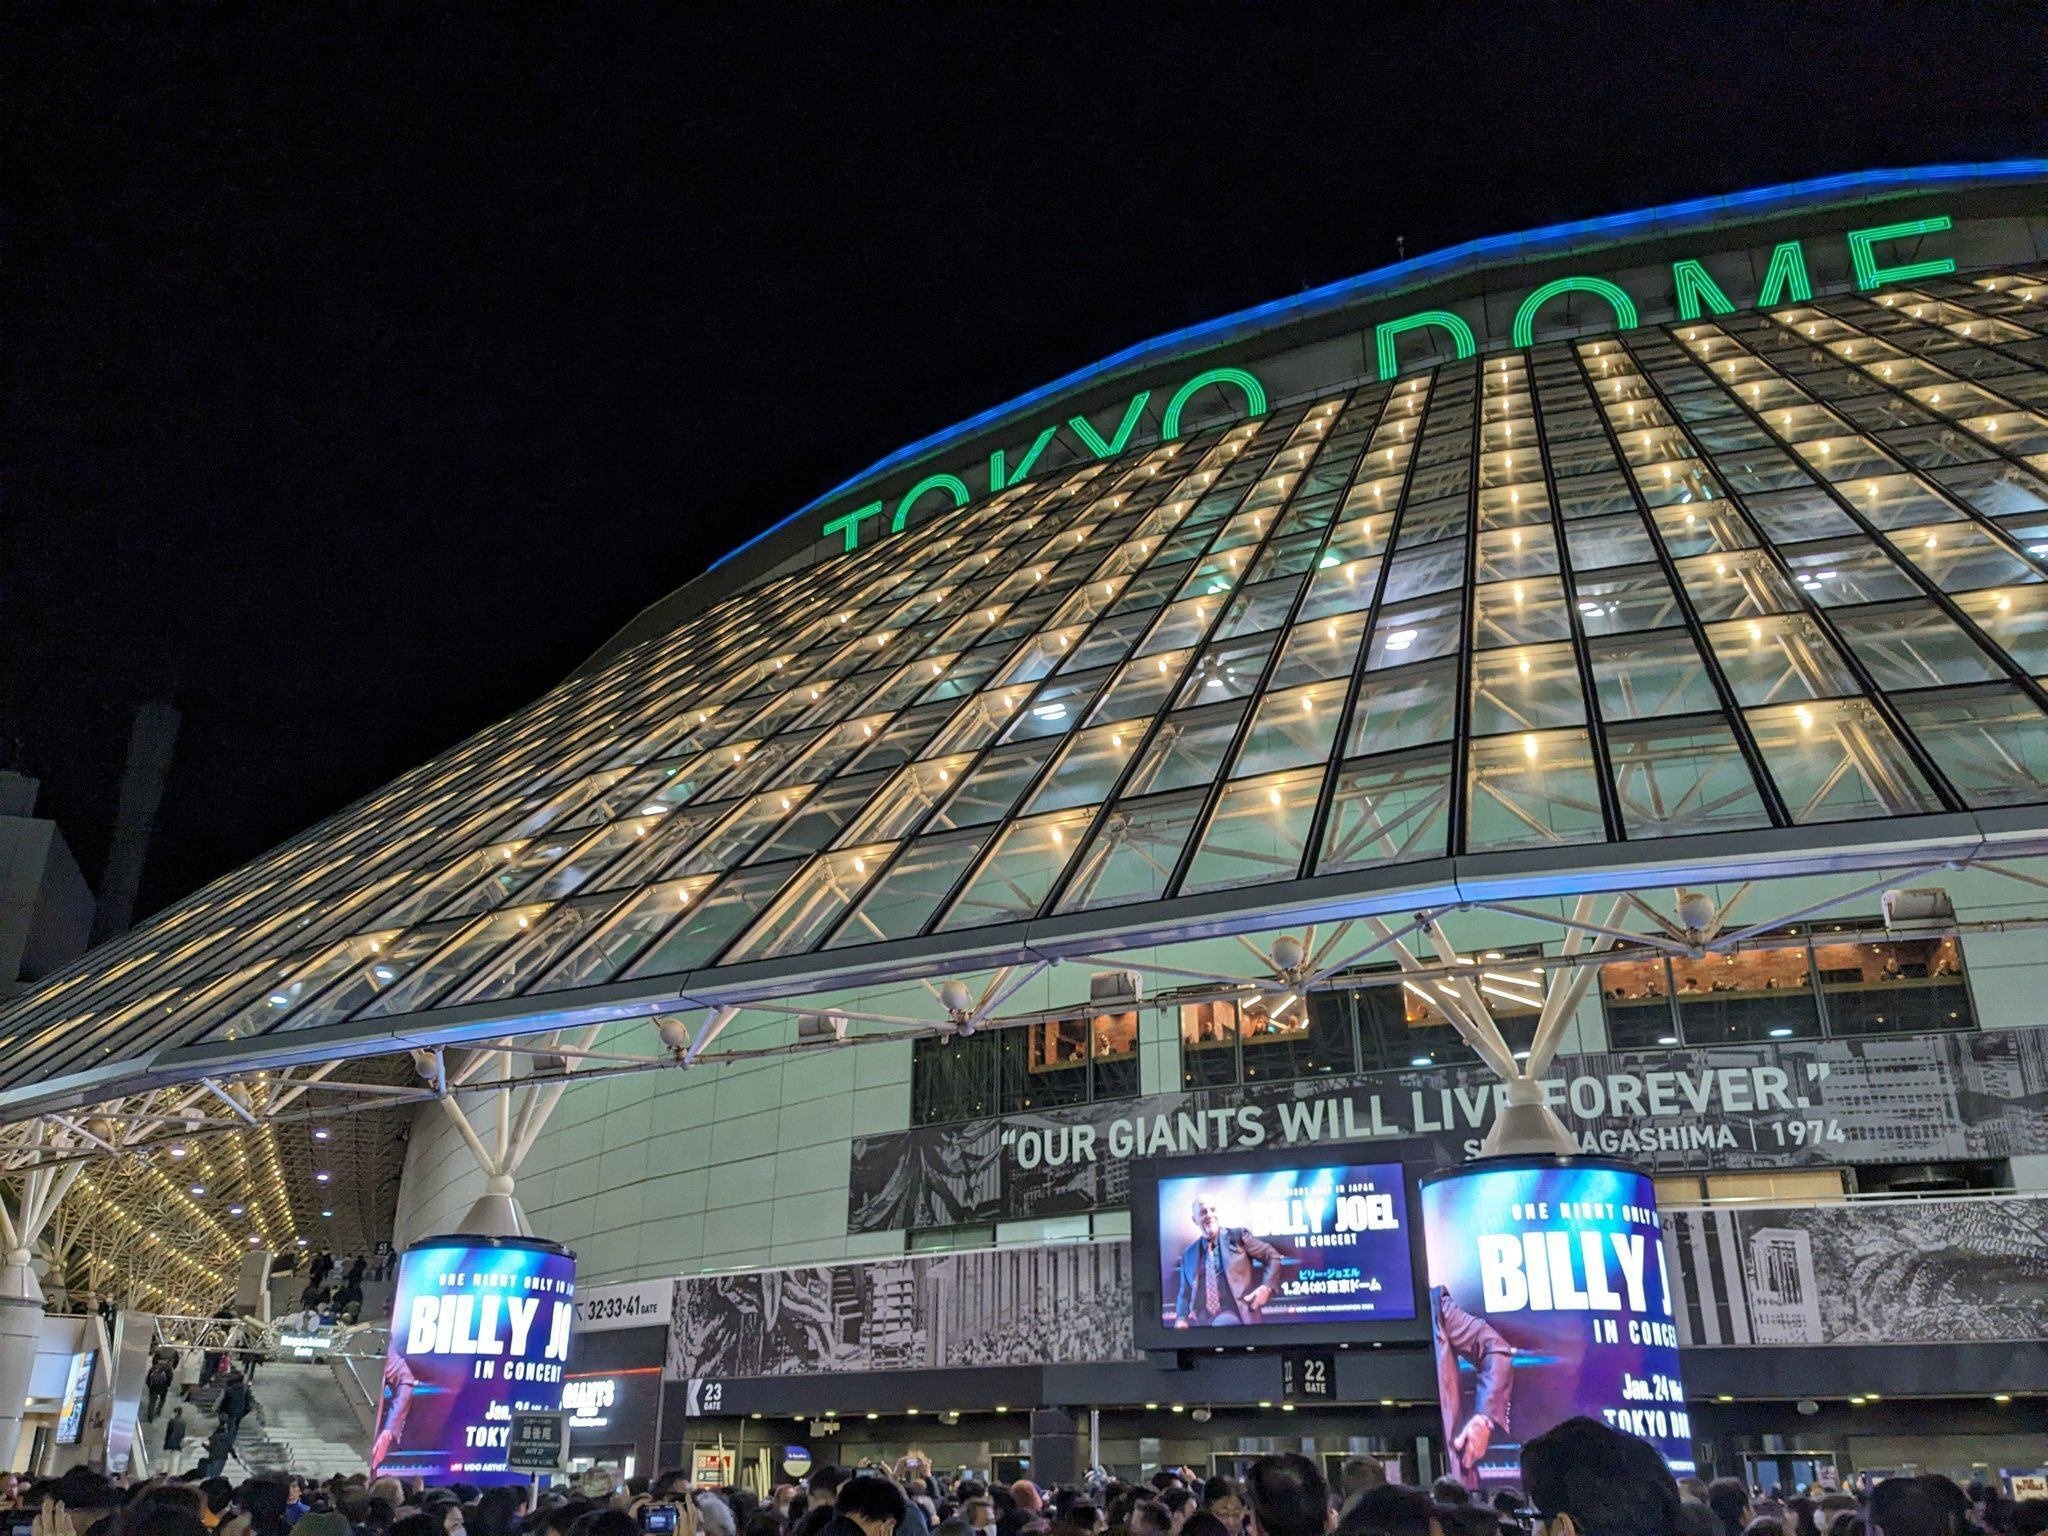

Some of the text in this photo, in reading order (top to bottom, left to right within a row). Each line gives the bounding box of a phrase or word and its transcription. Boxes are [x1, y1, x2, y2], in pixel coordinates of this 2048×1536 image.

[823, 216, 1956, 552] TOKYO DOME
[1109, 1105, 1267, 1158] GIANTS
[1278, 1094, 1399, 1143] WILL
[1572, 1119, 1846, 1154] AGASHIMA 1974
[1349, 1182, 1375, 1193] JAPAN
[1335, 1194, 1399, 1232] JOEL
[1511, 1202, 1549, 1220] ONE
[1559, 1202, 1614, 1220] NIGHT
[1622, 1204, 1650, 1225] ONLY
[1294, 1233, 1357, 1248] IN CONCERT
[439, 1272, 465, 1287] ONE
[472, 1273, 518, 1288] NIGHT
[523, 1276, 553, 1292] ONLY
[1477, 1230, 1647, 1314] BILLY
[641, 1303, 657, 1314] GATE
[406, 1294, 540, 1357] BILLY
[1593, 1319, 1619, 1344] IN
[475, 1361, 562, 1383] IN CONCERT
[1304, 1359, 1325, 1381] 22
[704, 1383, 722, 1401] 23
[1304, 1382, 1326, 1394] GATE
[1622, 1373, 1654, 1400] Jan.
[1652, 1374, 1669, 1401] 24
[485, 1400, 512, 1421] Jan.
[703, 1401, 721, 1411] GATE
[1603, 1409, 1667, 1438] TOKYO
